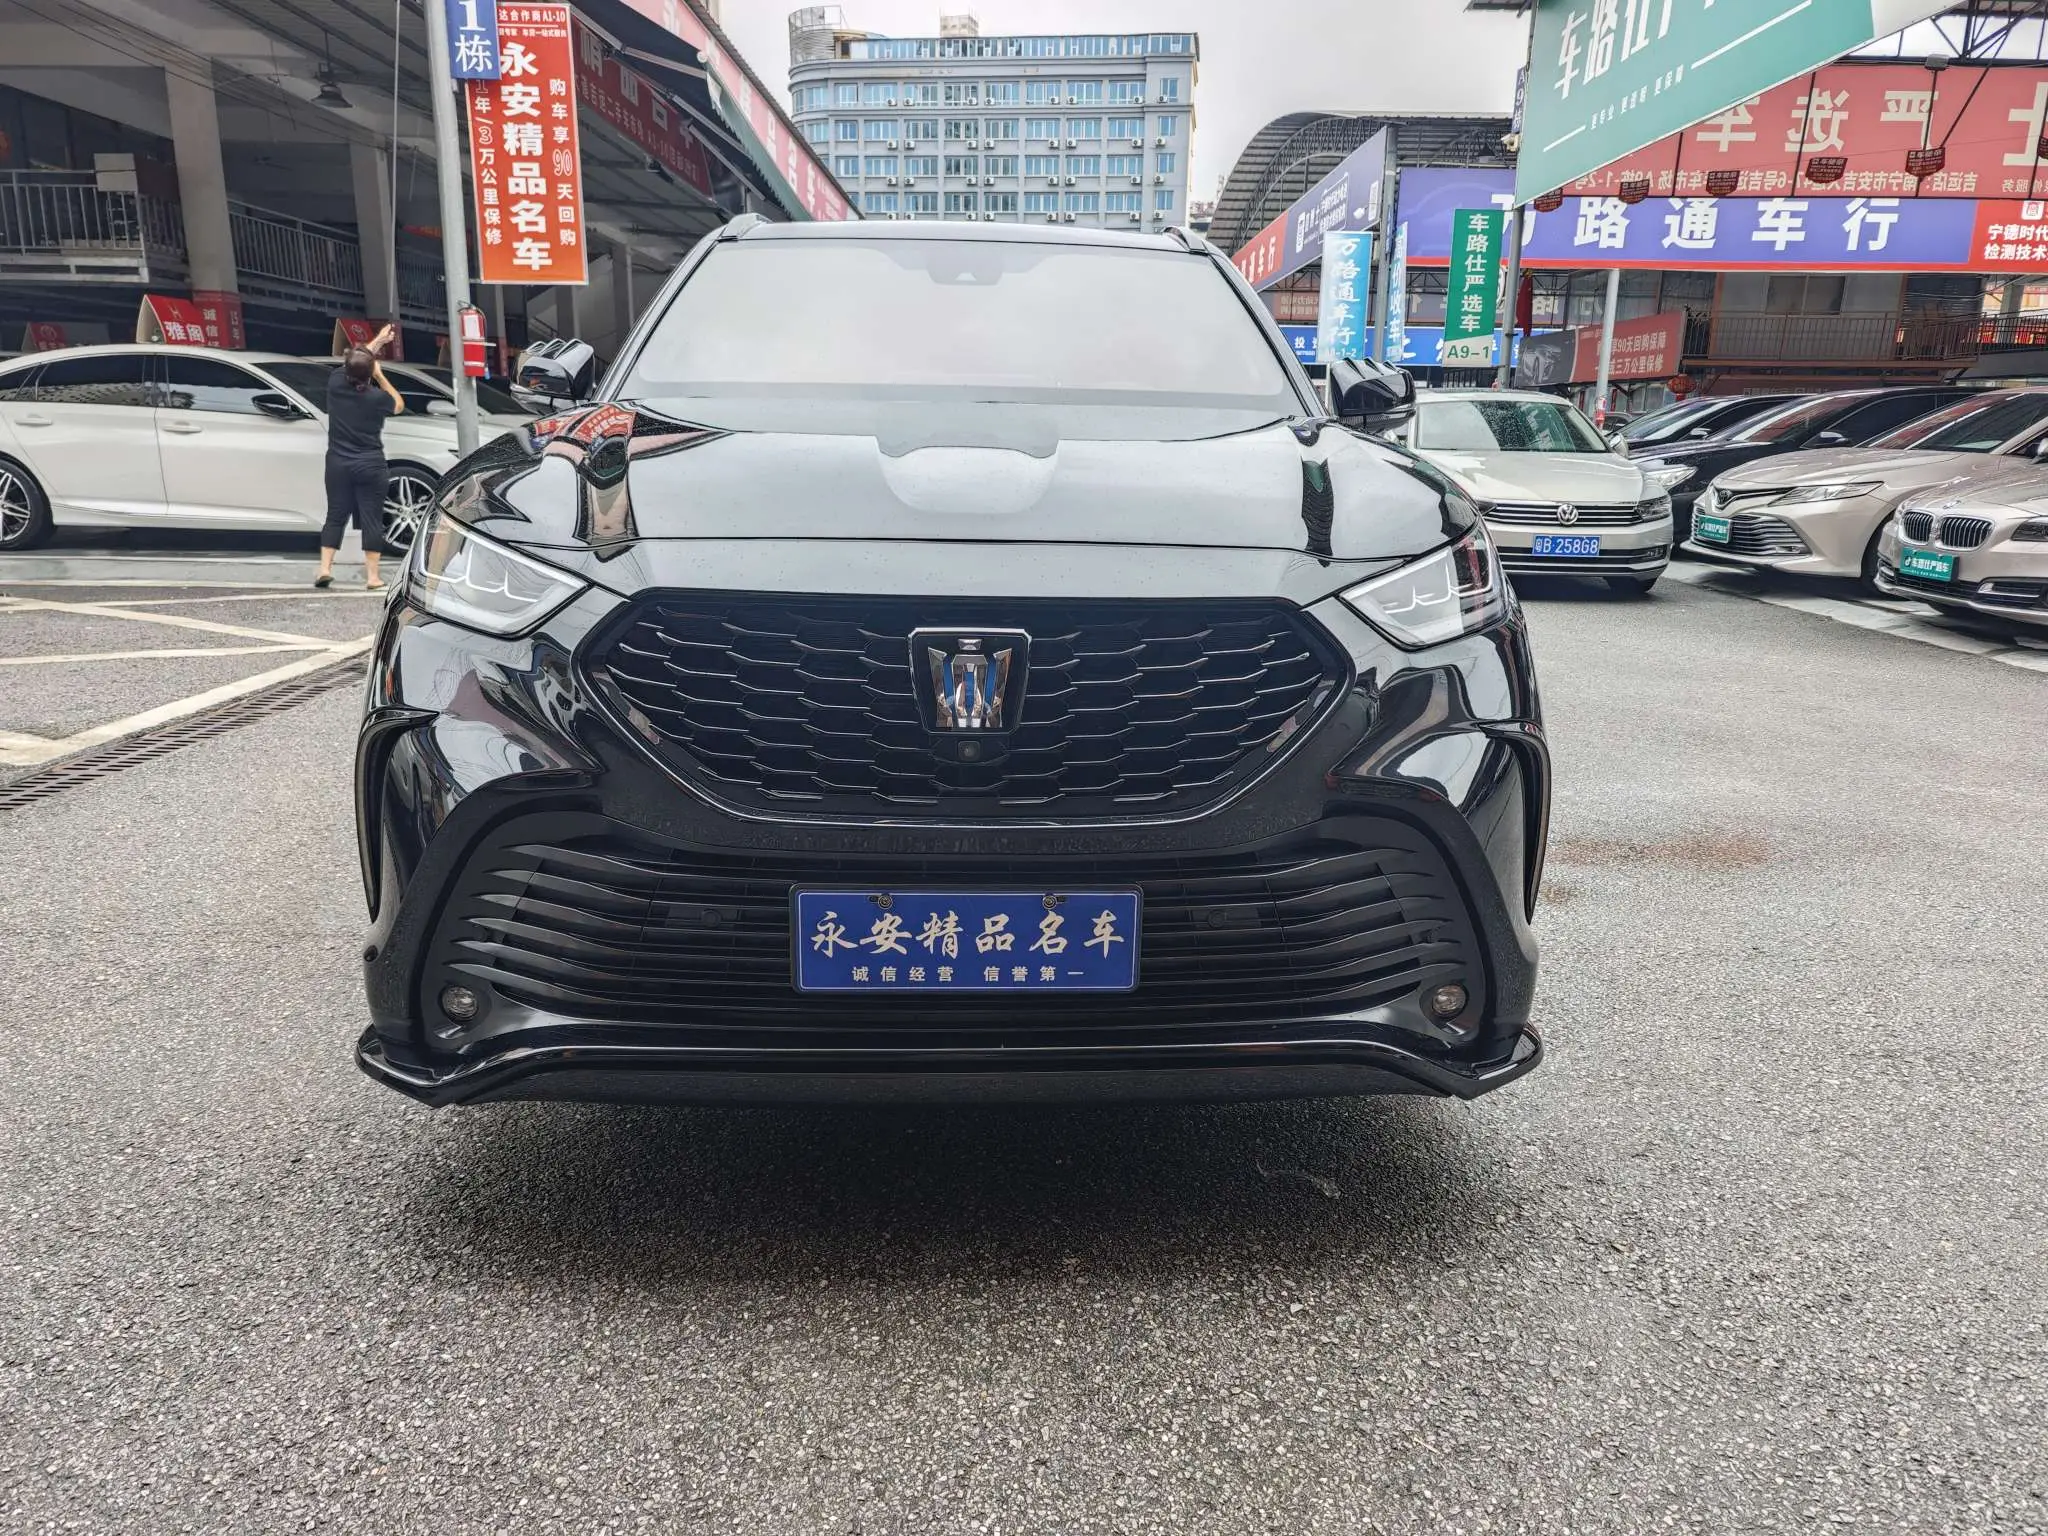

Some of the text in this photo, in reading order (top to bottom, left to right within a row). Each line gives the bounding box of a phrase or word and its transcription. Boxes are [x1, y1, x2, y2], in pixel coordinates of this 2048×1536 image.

[500, 41, 553, 271] 永安精品名车
[548, 78, 577, 246] 购车享90天回购
[1459, 213, 1490, 333] 车路仕严选车
[1447, 344, 1490, 359] A9-1
[810, 909, 1125, 959] 永安精品名车
[852, 966, 1084, 982] 诚信经营 信誉第一
